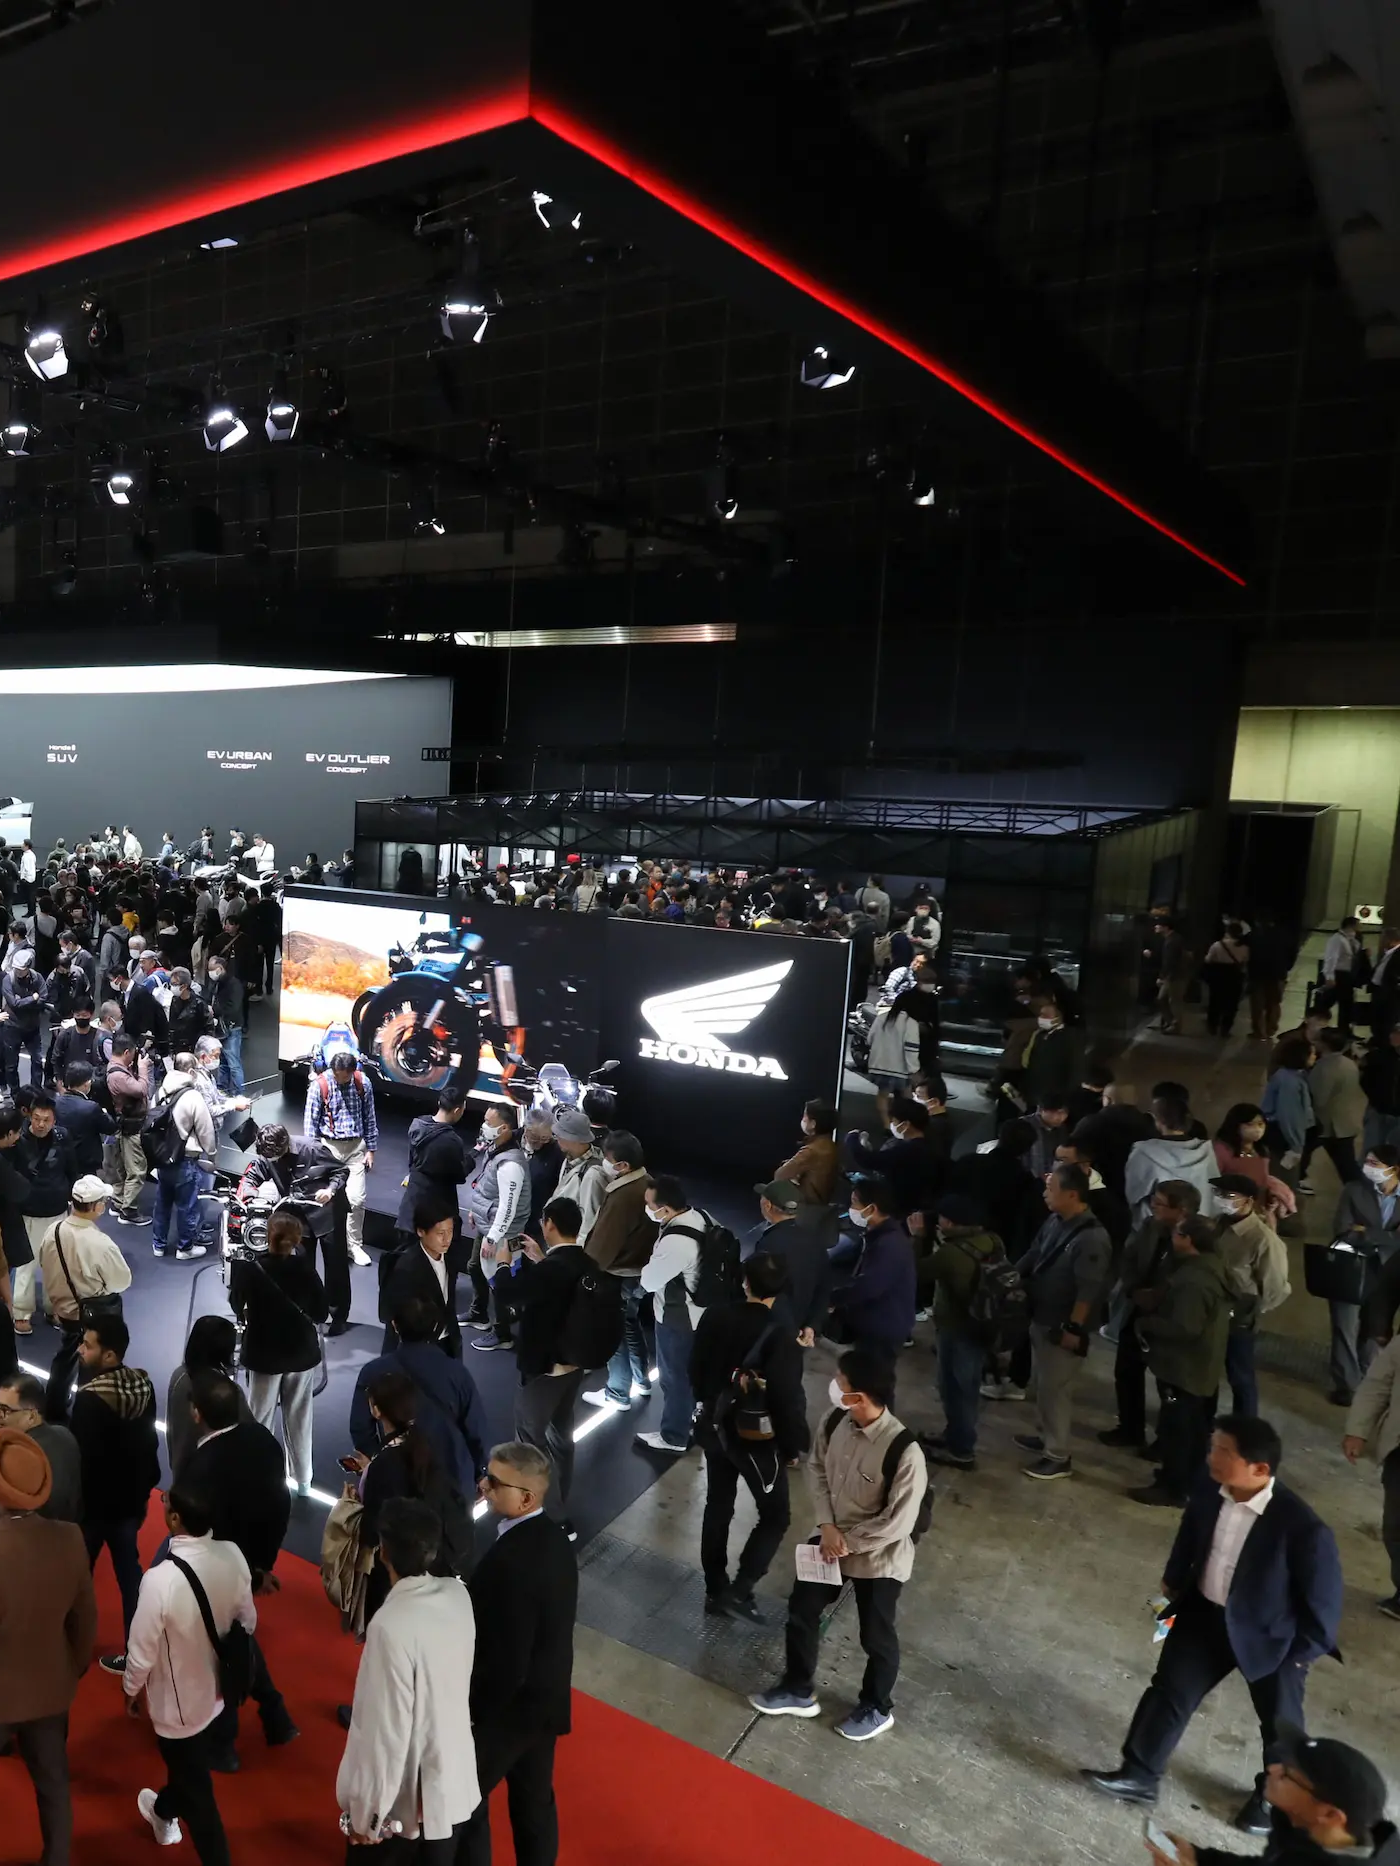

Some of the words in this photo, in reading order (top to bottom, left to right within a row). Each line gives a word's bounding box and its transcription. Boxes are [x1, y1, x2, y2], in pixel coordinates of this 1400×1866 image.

[46, 753, 79, 764] SUV
[206, 750, 226, 759] EV
[226, 751, 273, 761] URBAN
[305, 753, 325, 763] EV
[328, 754, 391, 765] OUTLIER
[220, 762, 258, 770] CONCEPT
[326, 766, 368, 774] CONCEPT
[638, 1038, 789, 1081] HONDA
